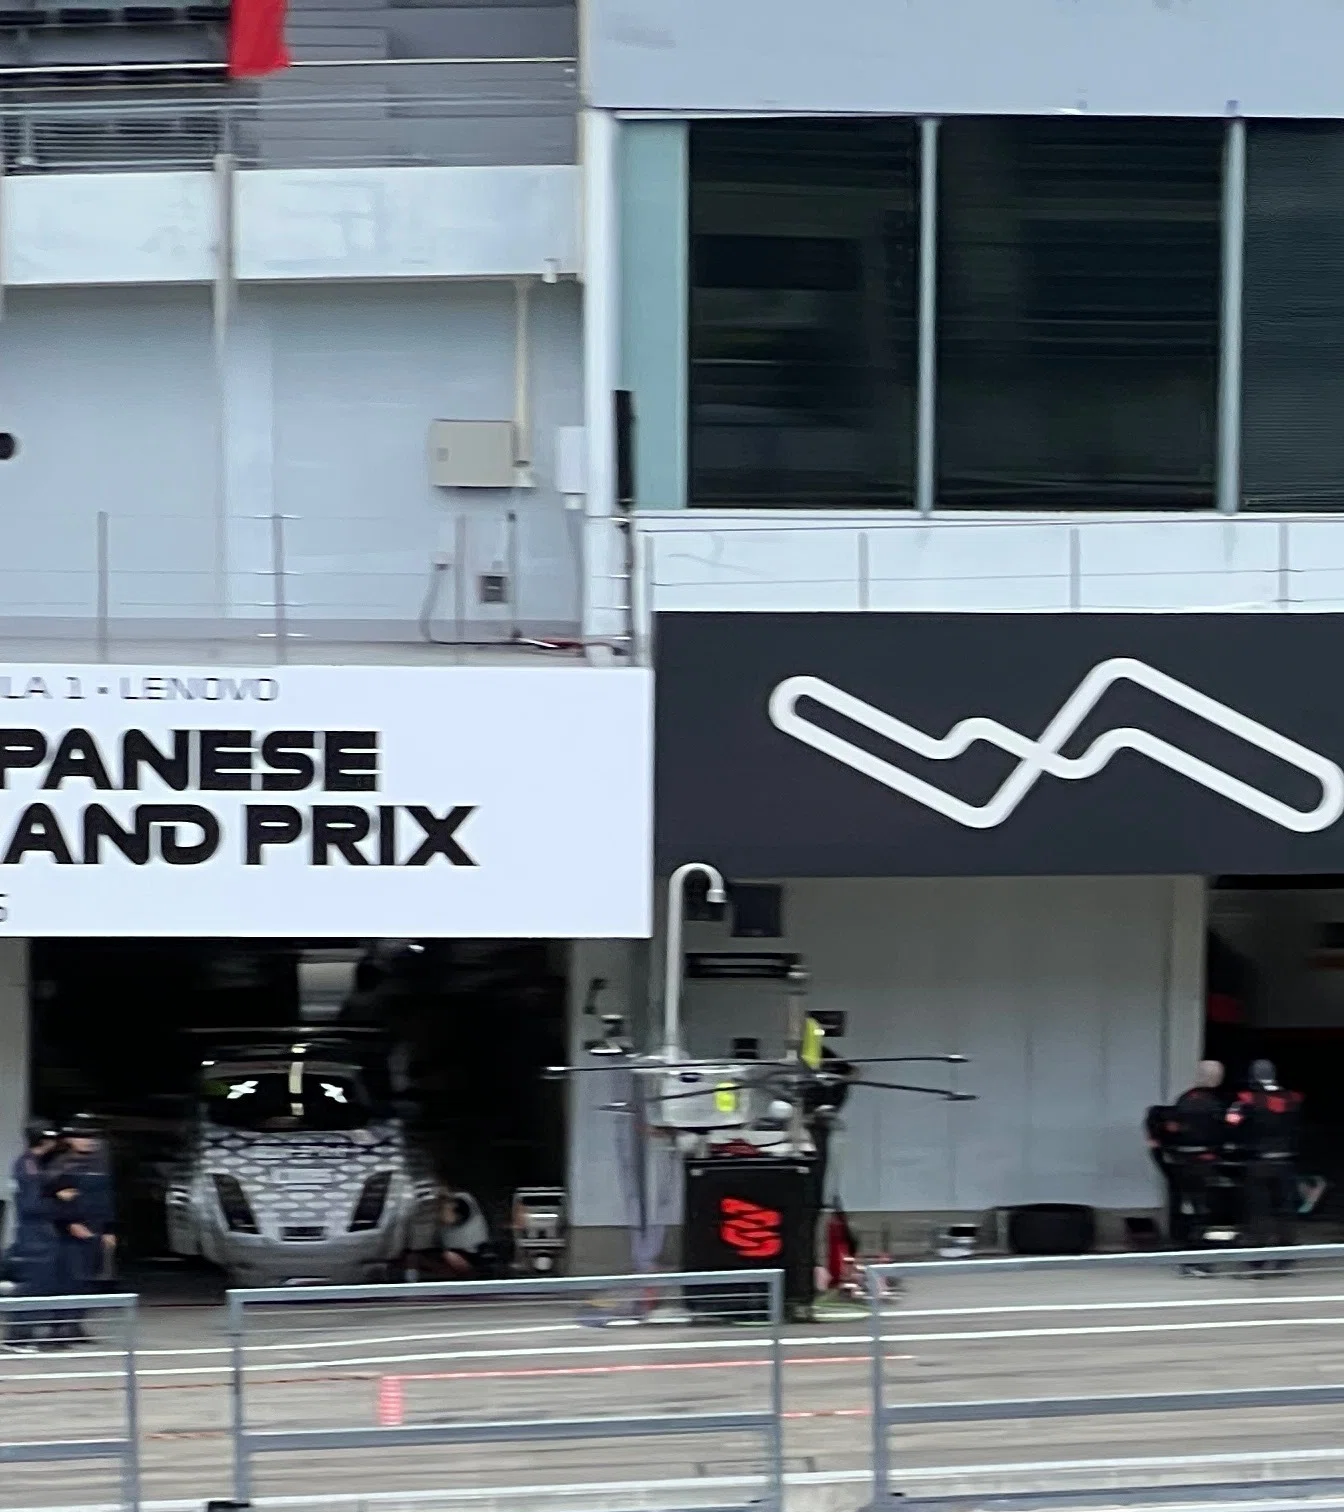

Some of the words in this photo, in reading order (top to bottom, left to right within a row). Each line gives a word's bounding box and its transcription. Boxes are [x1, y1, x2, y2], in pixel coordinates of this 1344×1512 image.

[120, 678, 279, 701] LENOVO
[0, 728, 380, 791] PANESE
[2, 803, 219, 865] AND
[246, 804, 480, 866] PRIX
